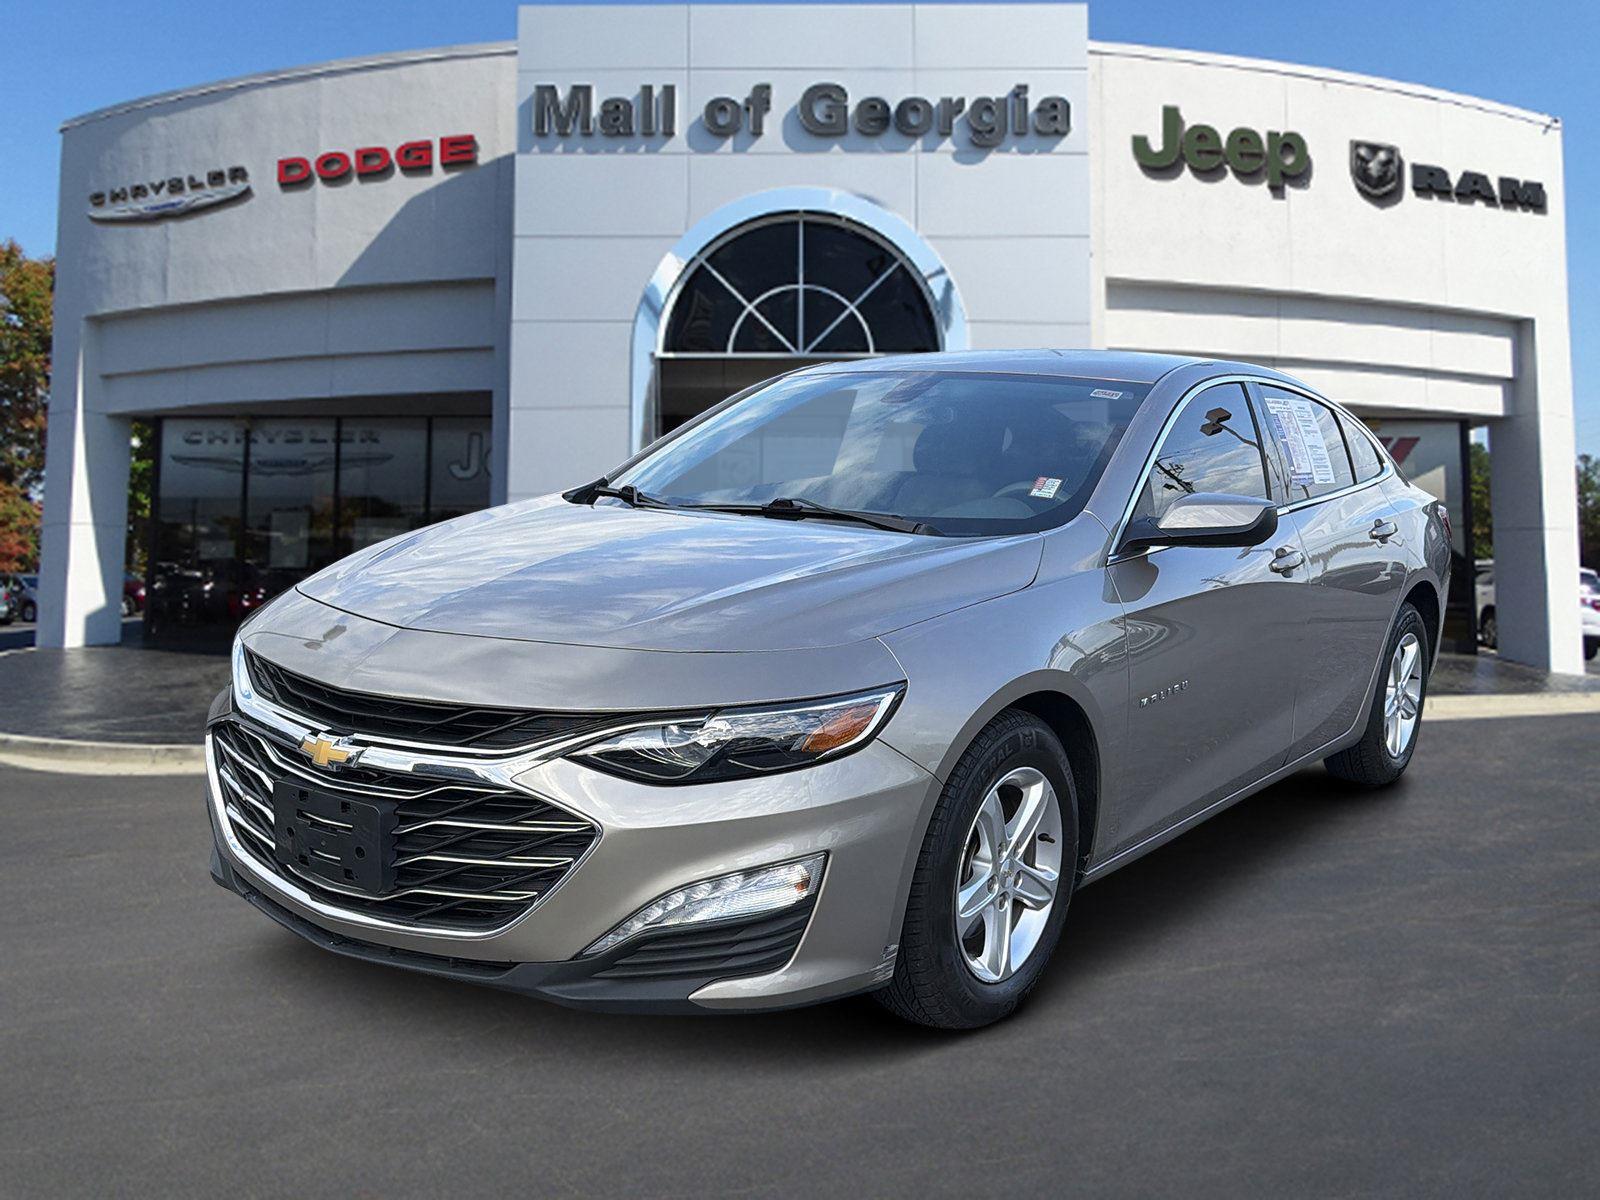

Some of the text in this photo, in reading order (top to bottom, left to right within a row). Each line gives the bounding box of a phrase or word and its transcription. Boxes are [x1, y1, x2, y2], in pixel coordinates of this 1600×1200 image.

[532, 82, 1072, 149] Mall of Georgia
[277, 134, 477, 187] DODGE
[1132, 105, 1309, 188] Jeep
[89, 166, 249, 207] CHRYSLER
[1411, 162, 1548, 214] RAM
[182, 429, 381, 444] CHRYSLER
